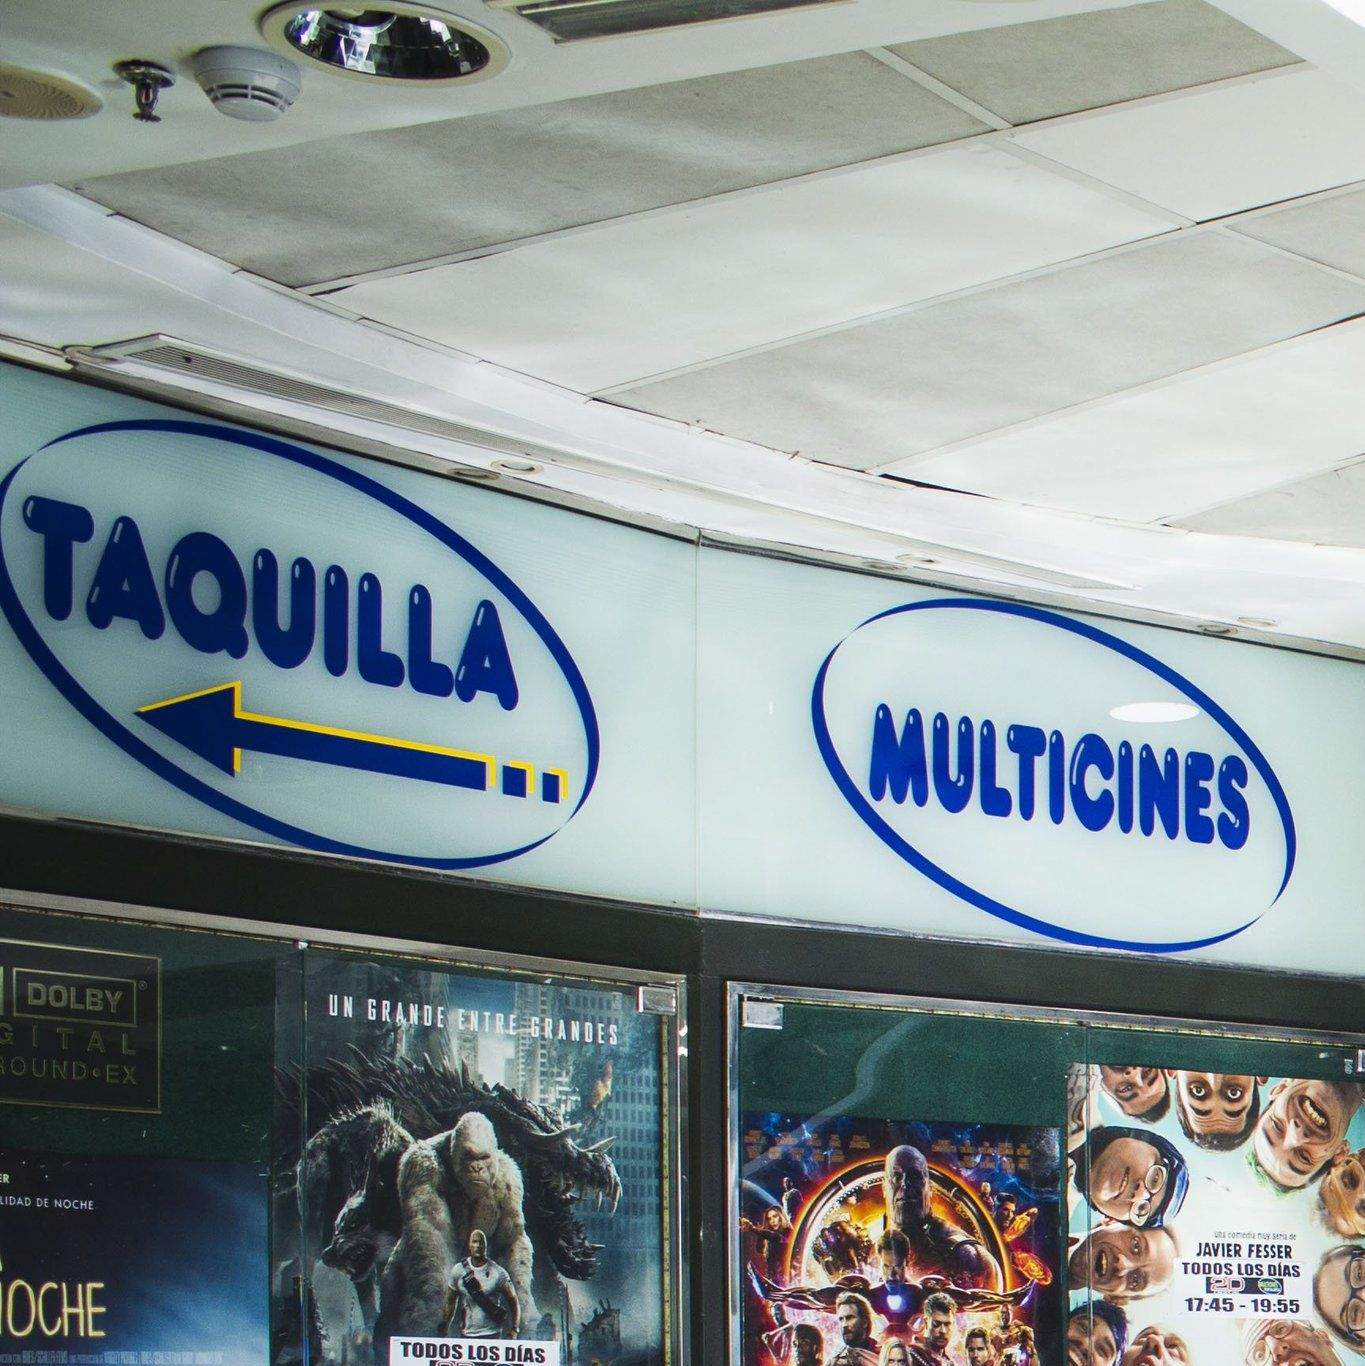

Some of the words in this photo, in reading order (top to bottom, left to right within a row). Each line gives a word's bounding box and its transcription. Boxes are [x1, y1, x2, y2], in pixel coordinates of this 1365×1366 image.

[22, 495, 518, 711] TAQUILLA
[869, 703, 1249, 850] MULTICINES
[28, 983, 123, 1013] DOLBY
[330, 994, 353, 1018] UN
[368, 999, 444, 1028] GRANDE
[459, 1009, 516, 1035] ENTRE
[531, 1018, 617, 1045] GRANDES
[1197, 1243, 1241, 1258] JAVIER
[1248, 1244, 1292, 1259] FESSER
[1182, 1262, 1233, 1275] TODOS
[1238, 1264, 1263, 1276] LOS
[1268, 1262, 1300, 1277] DÍAS
[1210, 1277, 1245, 1292] 2D
[1185, 1297, 1234, 1312] 17:45
[1251, 1299, 1299, 1313] 19:55
[401, 1341, 463, 1360] TODOS
[468, 1345, 500, 1362] LOS
[505, 1345, 546, 1363] DÍAS
